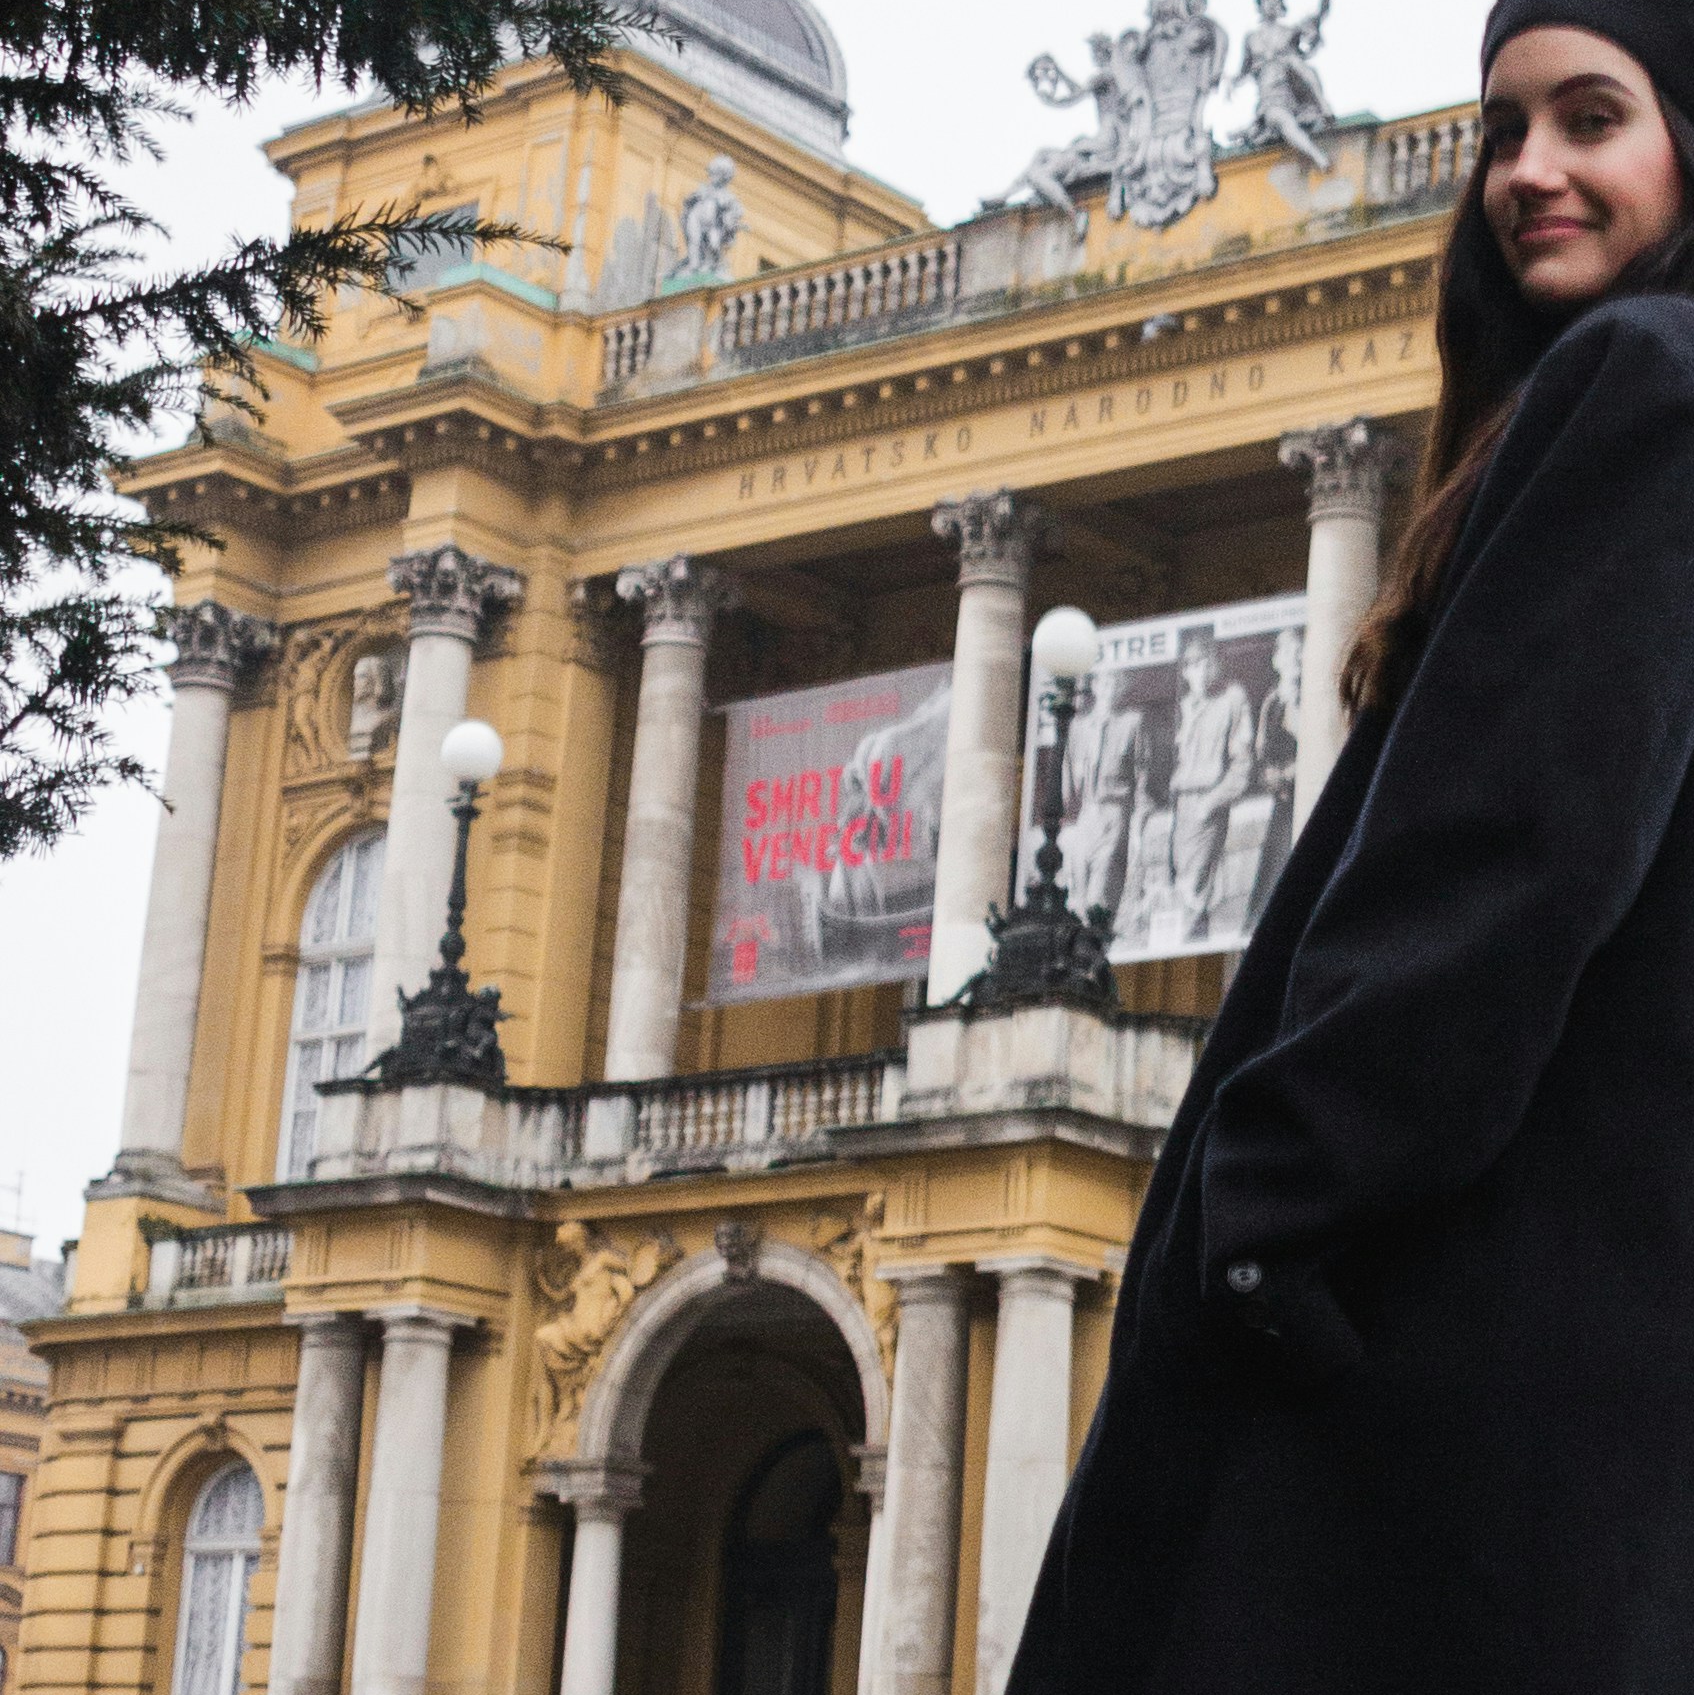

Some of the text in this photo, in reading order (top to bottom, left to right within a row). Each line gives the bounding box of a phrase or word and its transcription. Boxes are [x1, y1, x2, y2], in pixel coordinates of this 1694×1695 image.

[738, 424, 972, 500] HRVATSKO
[1029, 362, 1265, 438] NARODNO
[744, 755, 903, 831] SMRT U
[741, 810, 913, 884] VENECIJI
